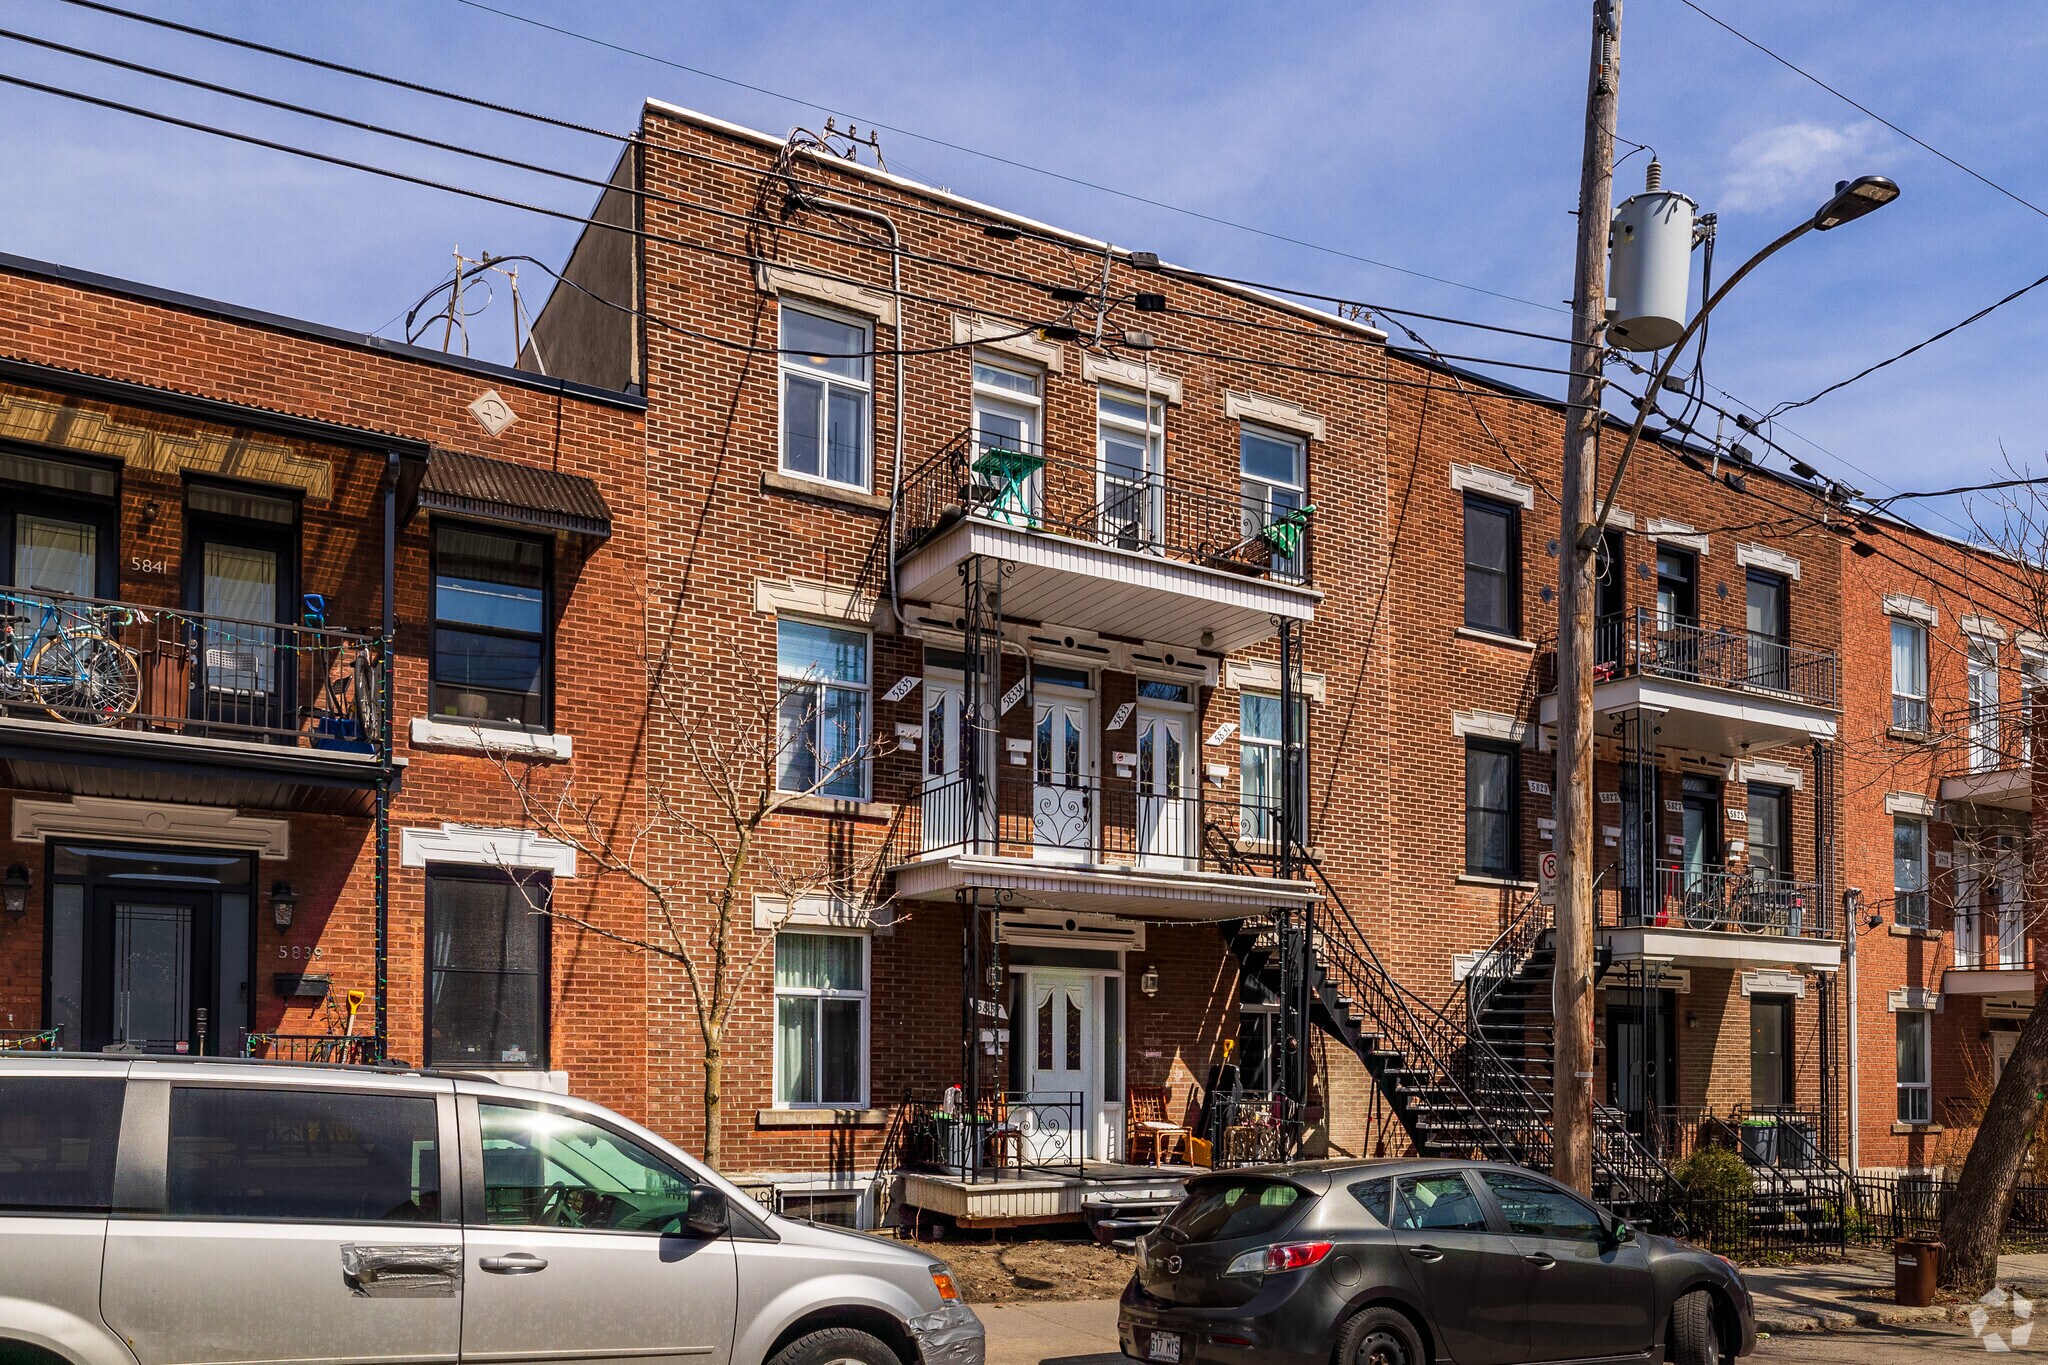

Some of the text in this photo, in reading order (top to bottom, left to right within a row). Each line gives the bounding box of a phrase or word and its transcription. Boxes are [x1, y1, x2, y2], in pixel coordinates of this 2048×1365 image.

[131, 556, 168, 575] 5841
[892, 677, 913, 700] 5835
[1002, 683, 1024, 708] 5833A
[1114, 704, 1130, 727] 5833
[1214, 724, 1230, 744] 5831
[1531, 782, 1548, 793] 5829
[1667, 801, 1682, 811] 5827
[1730, 810, 1744, 820] 5825
[278, 945, 323, 960] 5839
[1151, 1337, 1163, 1352] G17
